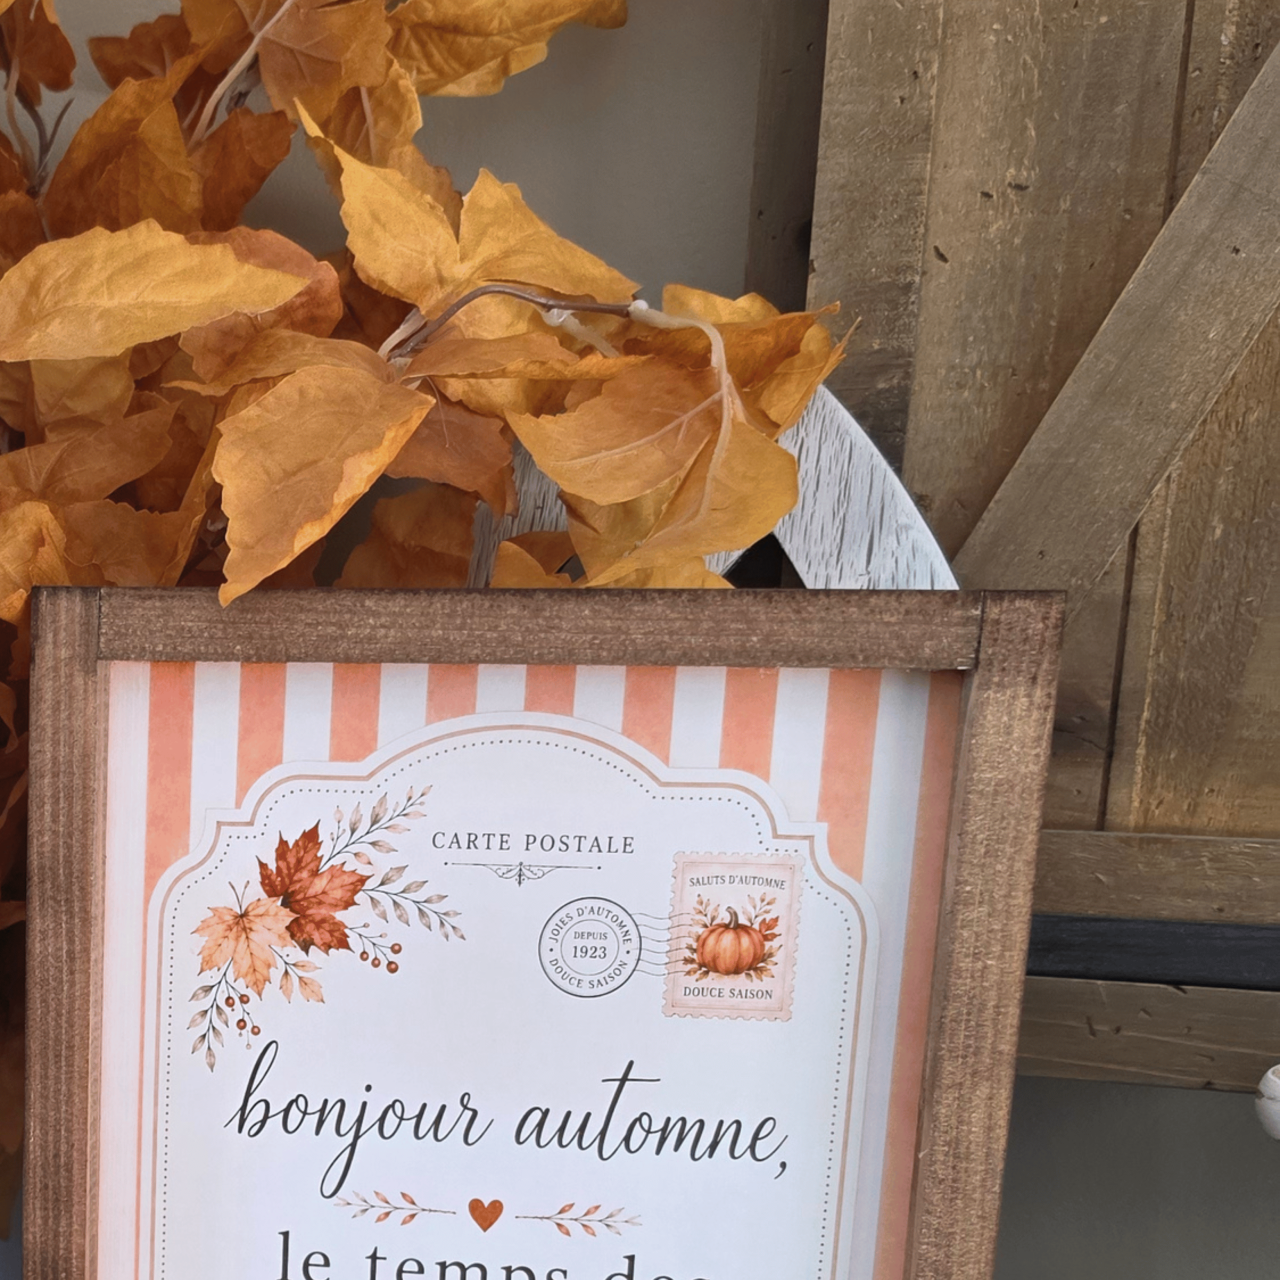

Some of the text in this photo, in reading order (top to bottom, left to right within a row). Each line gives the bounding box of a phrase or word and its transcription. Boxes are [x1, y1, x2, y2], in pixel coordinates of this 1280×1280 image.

[432, 831, 636, 854] CARTE POSTALE
[689, 875, 787, 890] SALUTS D'AUTOMNE
[548, 905, 632, 945] JOIES D'AUTOMNE
[573, 931, 608, 940] DEPUIS
[573, 945, 607, 959] 1923
[549, 958, 628, 989] DOUCE SAISON
[683, 986, 773, 1000] DOUCE SAISON
[223, 1040, 789, 1200] bonjour automne,
